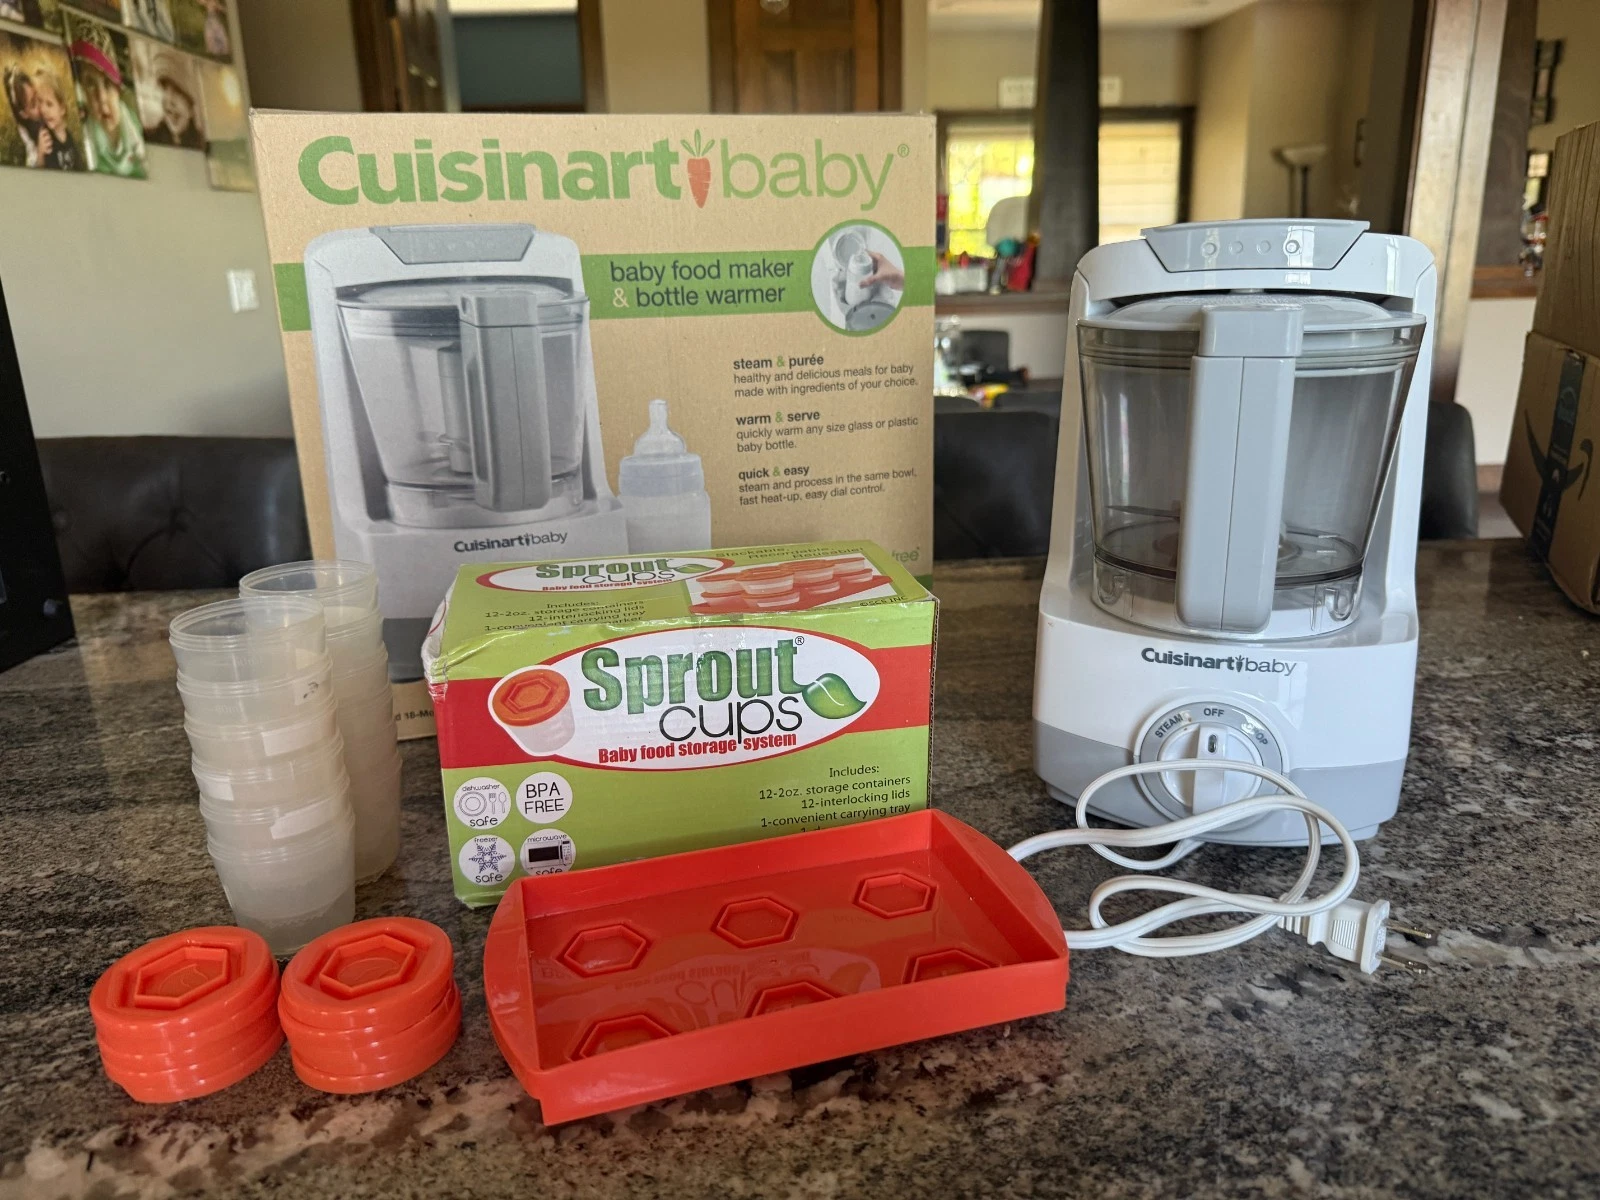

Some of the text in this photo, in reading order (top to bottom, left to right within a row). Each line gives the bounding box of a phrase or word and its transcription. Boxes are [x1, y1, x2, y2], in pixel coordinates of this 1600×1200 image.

[297, 134, 682, 206] Cuisinart
[611, 258, 794, 286] baby food maker
[612, 286, 786, 308] & bottle warmer
[733, 354, 824, 370] steam & purée
[734, 363, 914, 384] healthy and delicious meals for baby
[734, 376, 918, 398] made with ingredients of your choice.
[736, 410, 820, 425] warm & serve
[736, 415, 919, 441] quickly warm any size glass or plastic
[737, 439, 796, 453] baby bottle.
[738, 464, 810, 481] quick & easy
[738, 480, 770, 493] steam
[773, 478, 791, 490] and
[794, 476, 833, 489] process
[836, 474, 844, 484] in
[847, 472, 861, 483] the
[864, 471, 889, 482] same
[739, 494, 757, 506] fast
[805, 490, 827, 501] easy
[830, 487, 847, 497] dial
[850, 484, 885, 495] control.
[454, 531, 568, 553] Cuisinart baby
[582, 571, 675, 584] cups
[529, 609, 621, 621] 12-interlocking
[583, 600, 644, 611] containers
[1141, 647, 1297, 677] Cuisinart baby
[659, 696, 803, 745] cups
[1203, 707, 1225, 718] OFF
[1154, 713, 1184, 739] STEAM
[598, 733, 797, 764] Baby food storage system
[829, 765, 879, 778] Includes:
[462, 783, 500, 792] dishwasher
[525, 781, 560, 798] BPA
[759, 775, 911, 800] 12-2oz. storage containers
[524, 798, 564, 814] FREE
[801, 789, 910, 809] 12-interlocking lids
[470, 816, 498, 827] safe
[761, 803, 910, 828] 1-convenient carrying tray
[527, 834, 567, 842] microwave
[475, 872, 503, 883] safe
